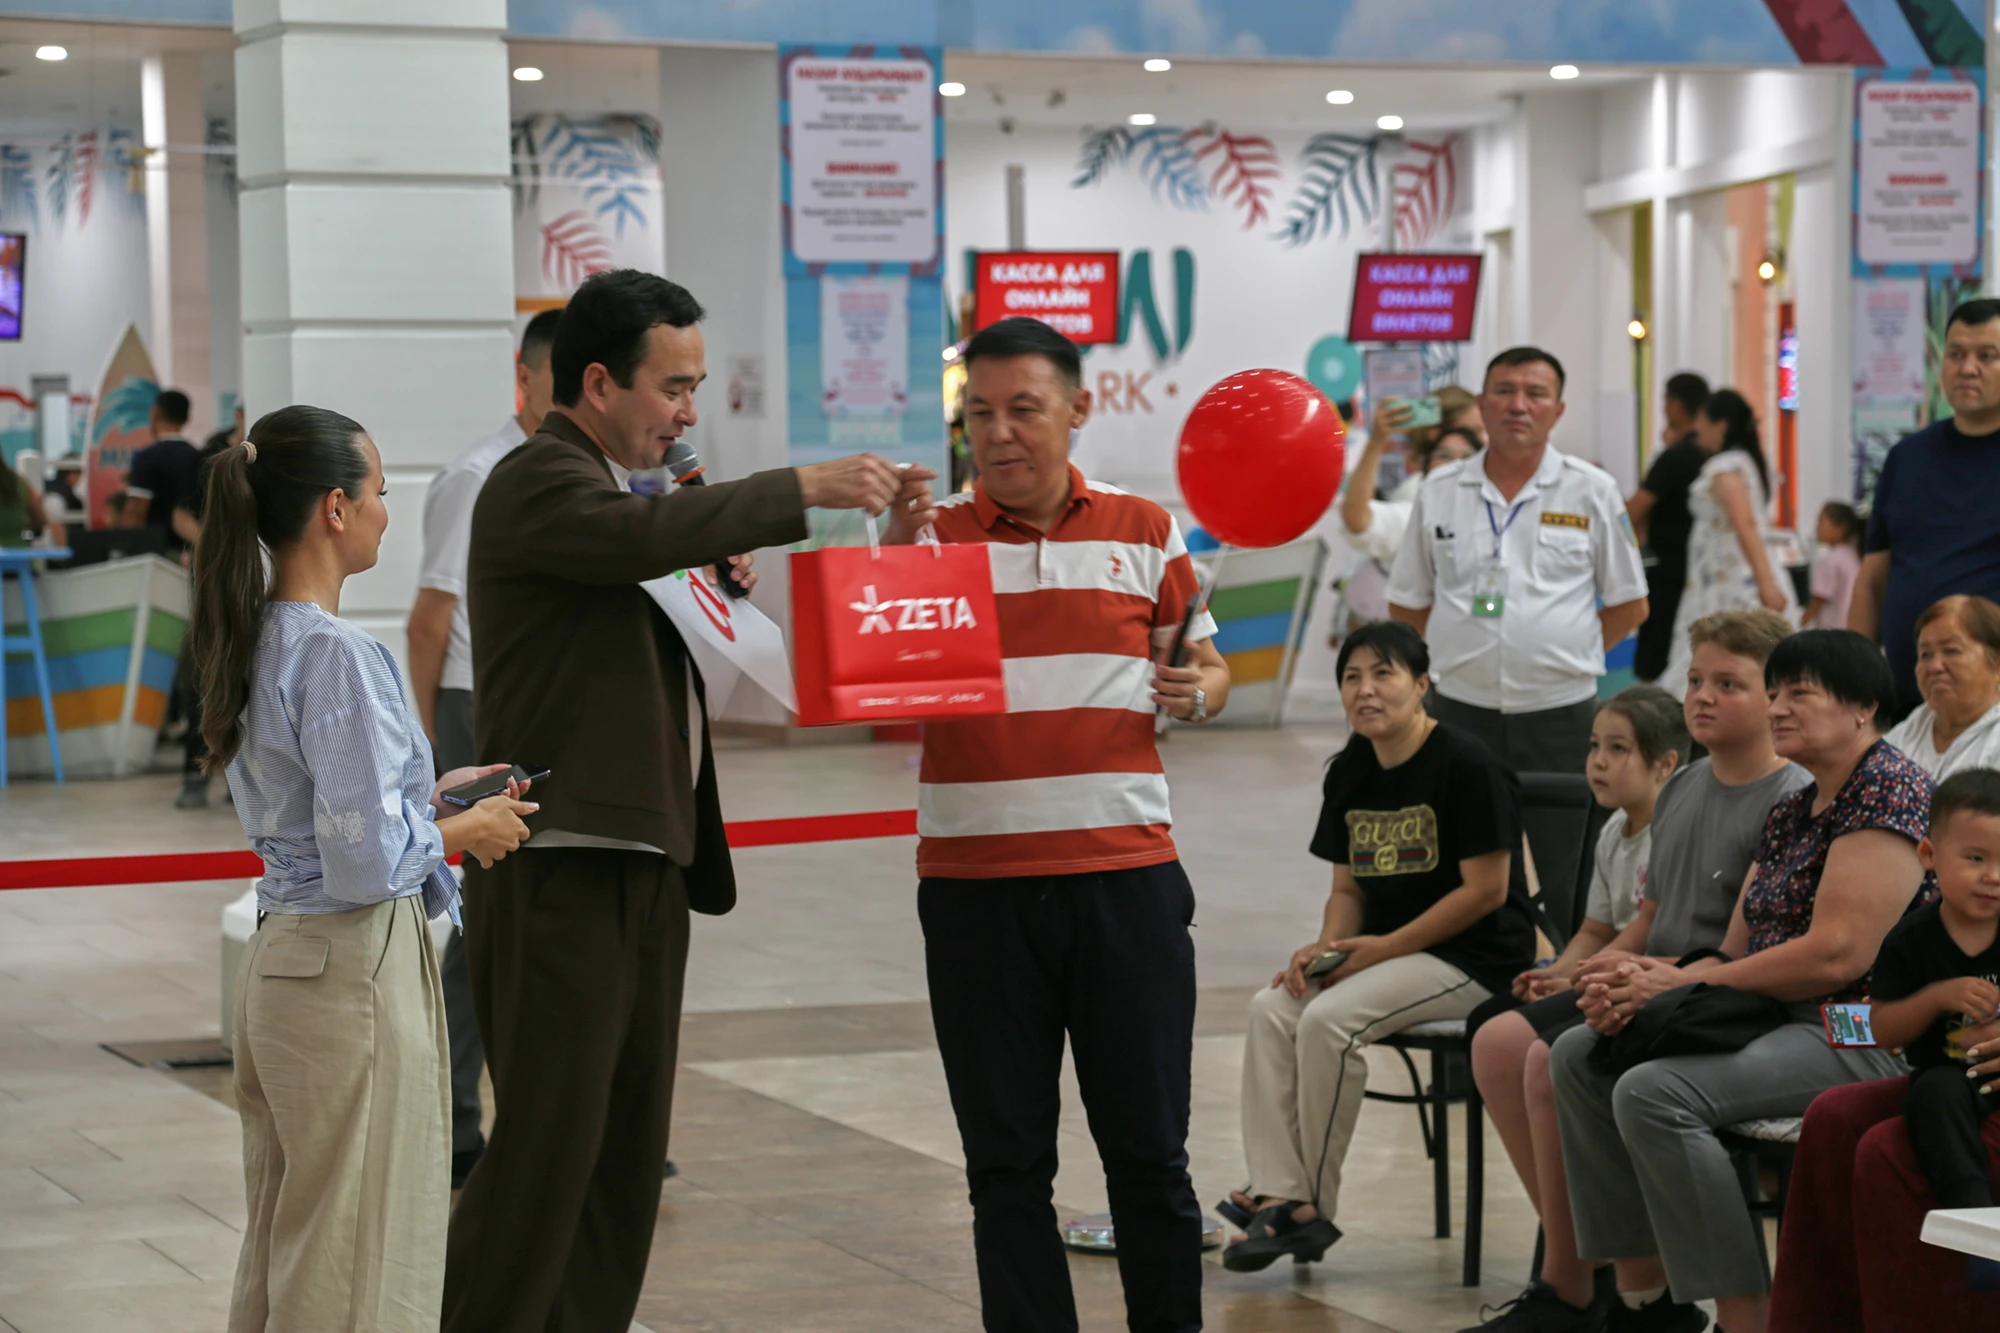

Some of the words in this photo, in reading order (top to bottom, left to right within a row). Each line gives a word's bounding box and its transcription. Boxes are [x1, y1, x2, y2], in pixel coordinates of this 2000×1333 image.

[990, 262, 1058, 284] КАССА
[1060, 262, 1106, 285] ДЛЯ
[1368, 264, 1428, 284] КАССА
[1429, 264, 1470, 286] ДЛЯ
[1003, 287, 1091, 309] ОНЛАЙН
[1377, 287, 1454, 309] ОНЛАЙН
[1371, 312, 1454, 333] БИЛЕТОВ
[896, 596, 977, 631] ZETA
[1353, 818, 1421, 846] GUCCI
